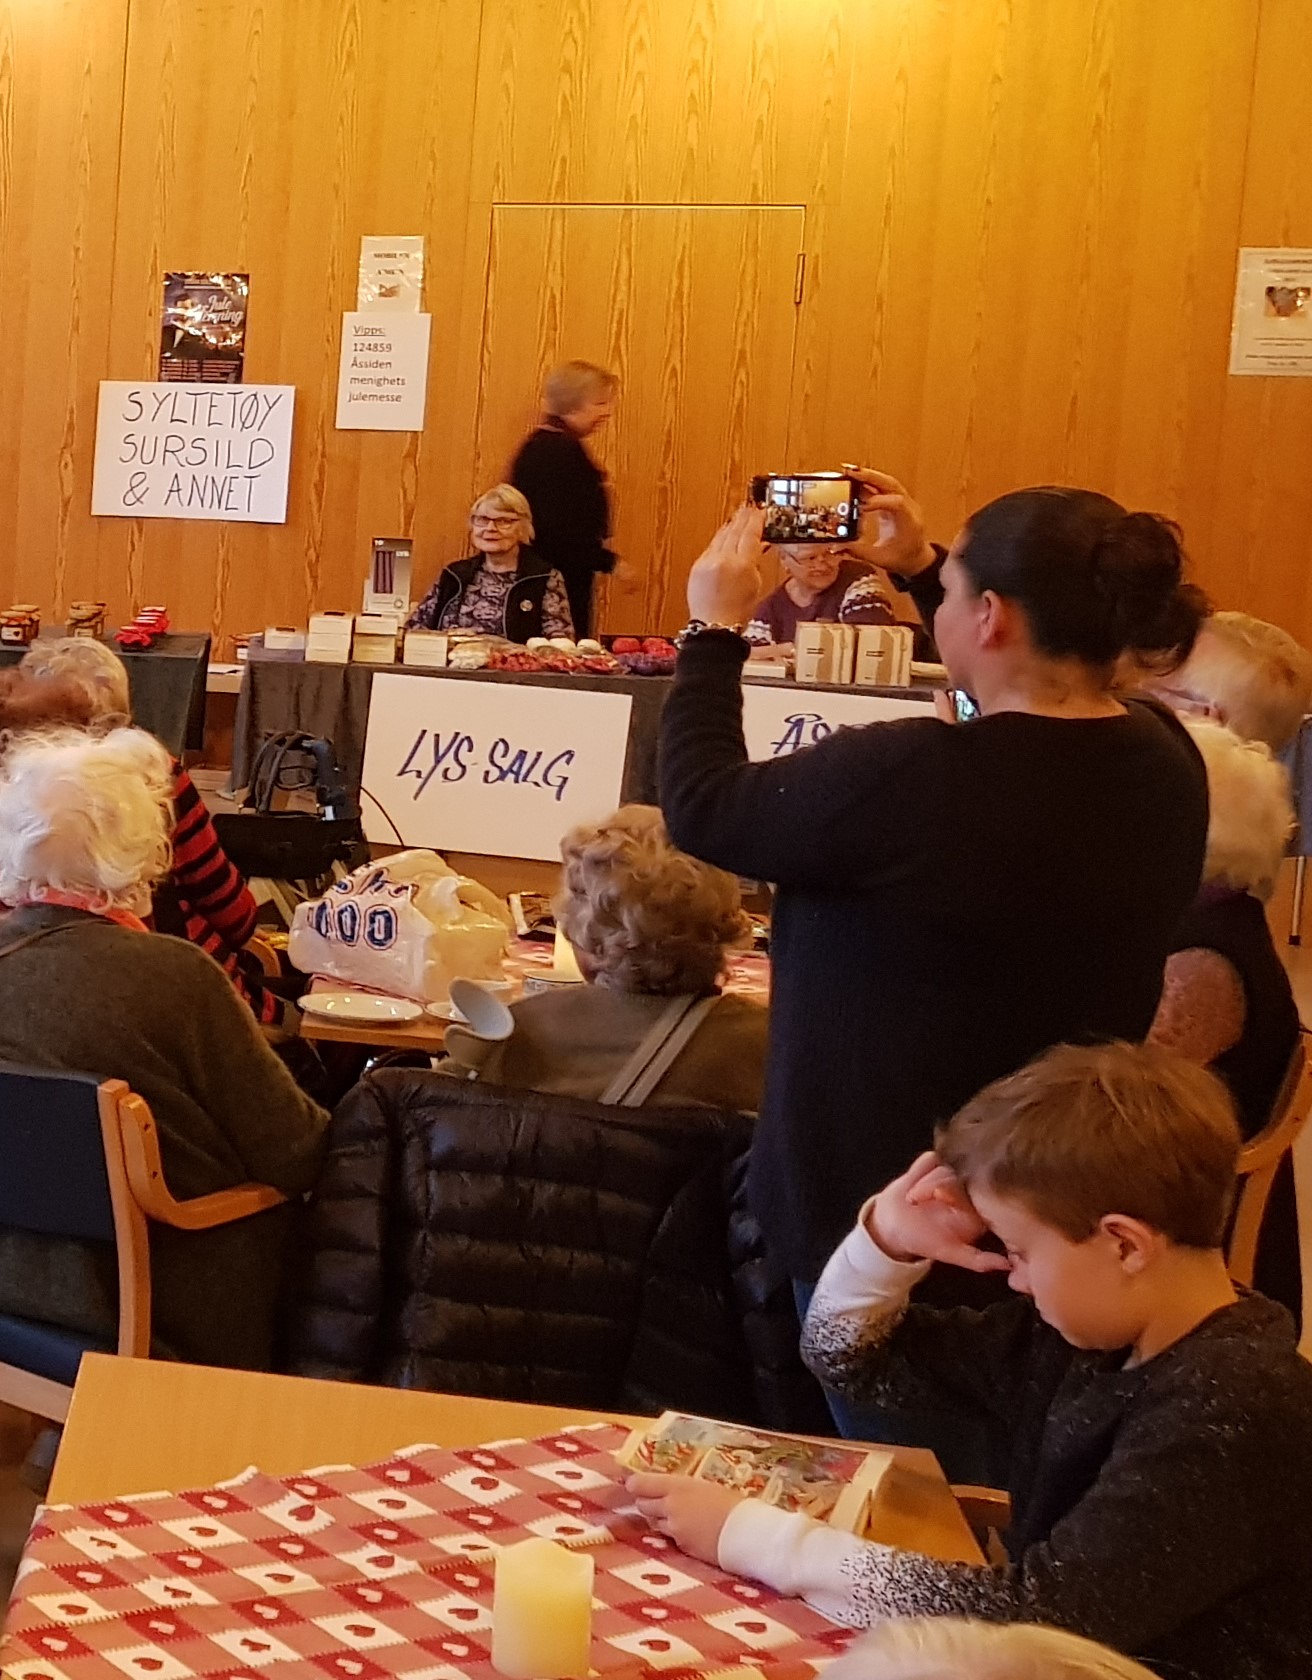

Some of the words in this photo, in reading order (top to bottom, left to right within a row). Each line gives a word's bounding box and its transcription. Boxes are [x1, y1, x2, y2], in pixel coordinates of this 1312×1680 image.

[353, 325, 386, 337] Vipps:
[353, 342, 393, 353] 124859
[350, 356, 393, 369] Åssiden
[349, 375, 407, 388] menighets
[347, 391, 403, 404] julemesse
[122, 391, 283, 432] SYLTETØY
[119, 433, 275, 470] SURSILD
[122, 471, 150, 507] &
[164, 472, 262, 513] ANNET
[396, 729, 474, 801] LYS
[482, 738, 576, 801] SALG
